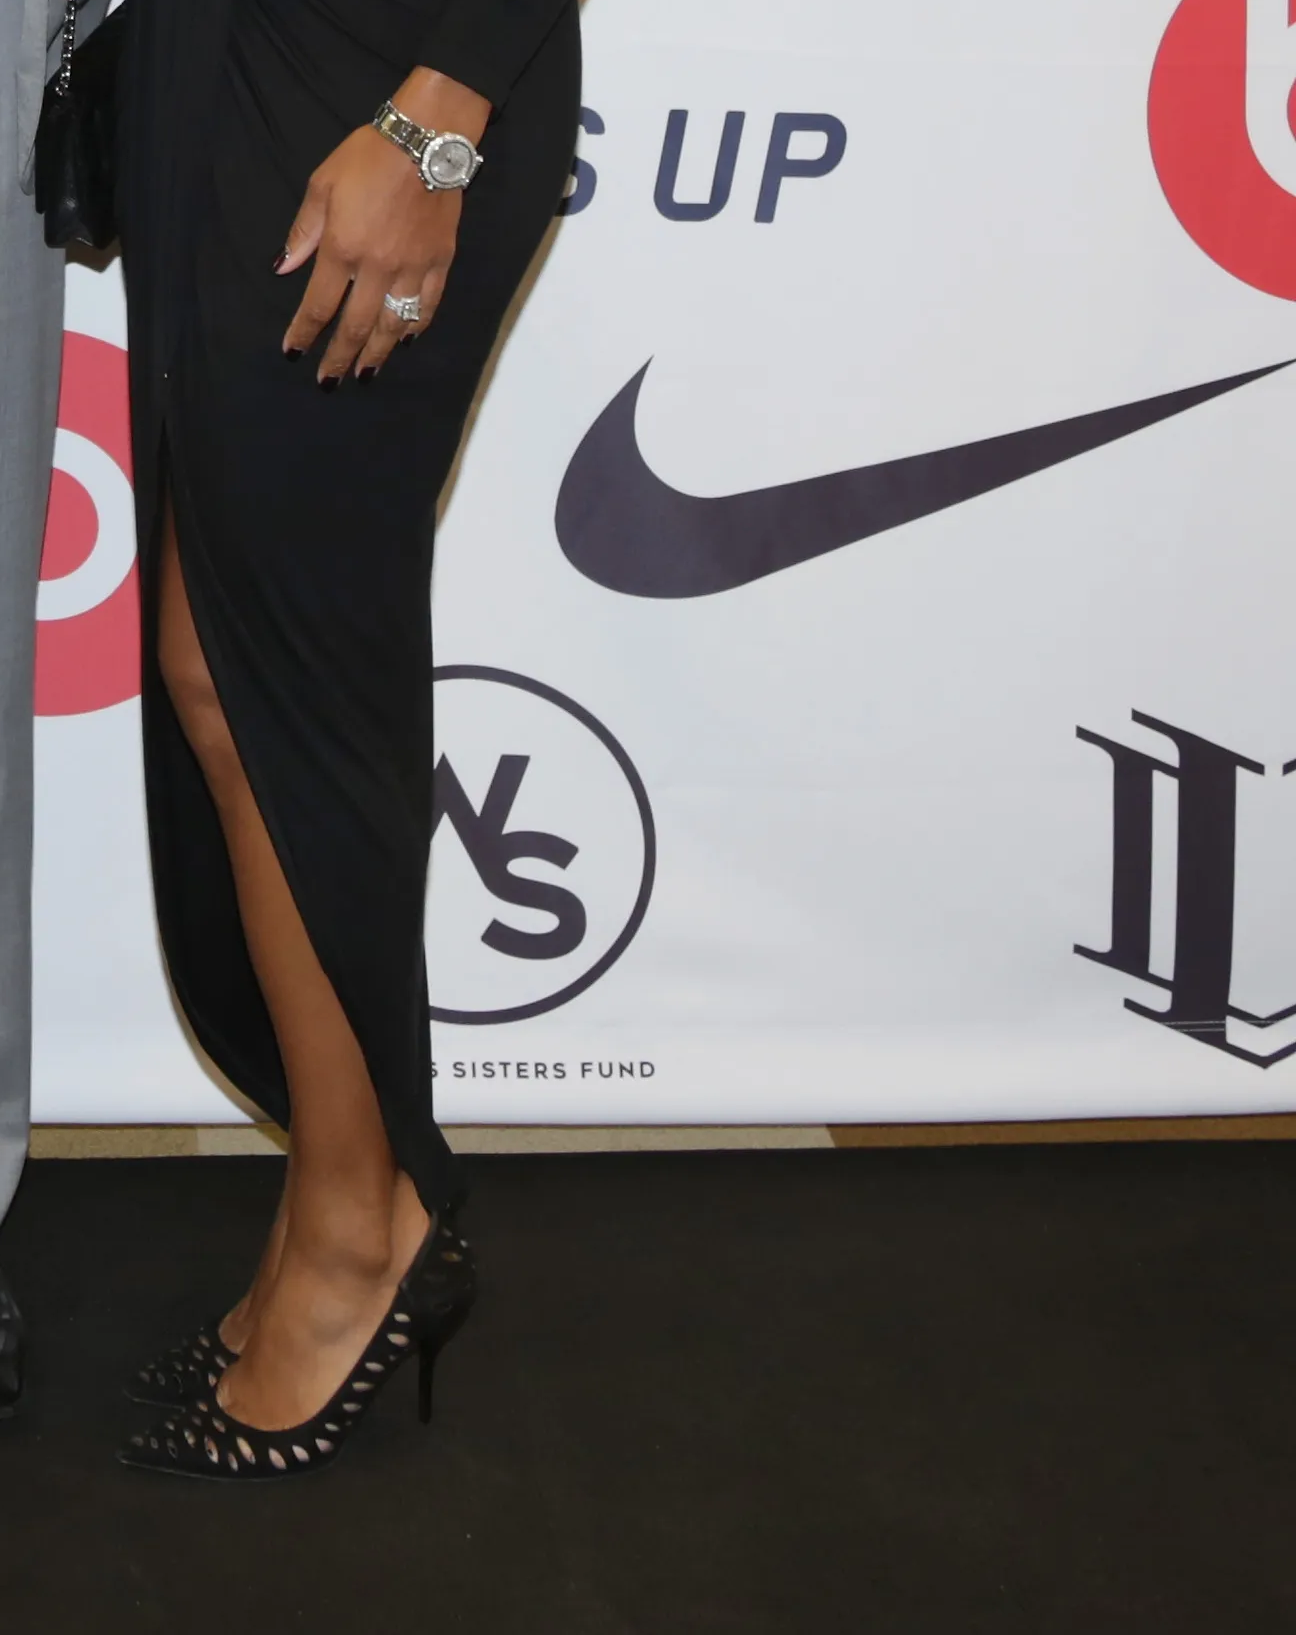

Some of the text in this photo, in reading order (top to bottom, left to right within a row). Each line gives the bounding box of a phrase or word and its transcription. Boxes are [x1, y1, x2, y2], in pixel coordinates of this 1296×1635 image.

[653, 109, 848, 223] UP
[452, 1061, 567, 1080] SISTERS
[580, 1061, 655, 1079] FUND
